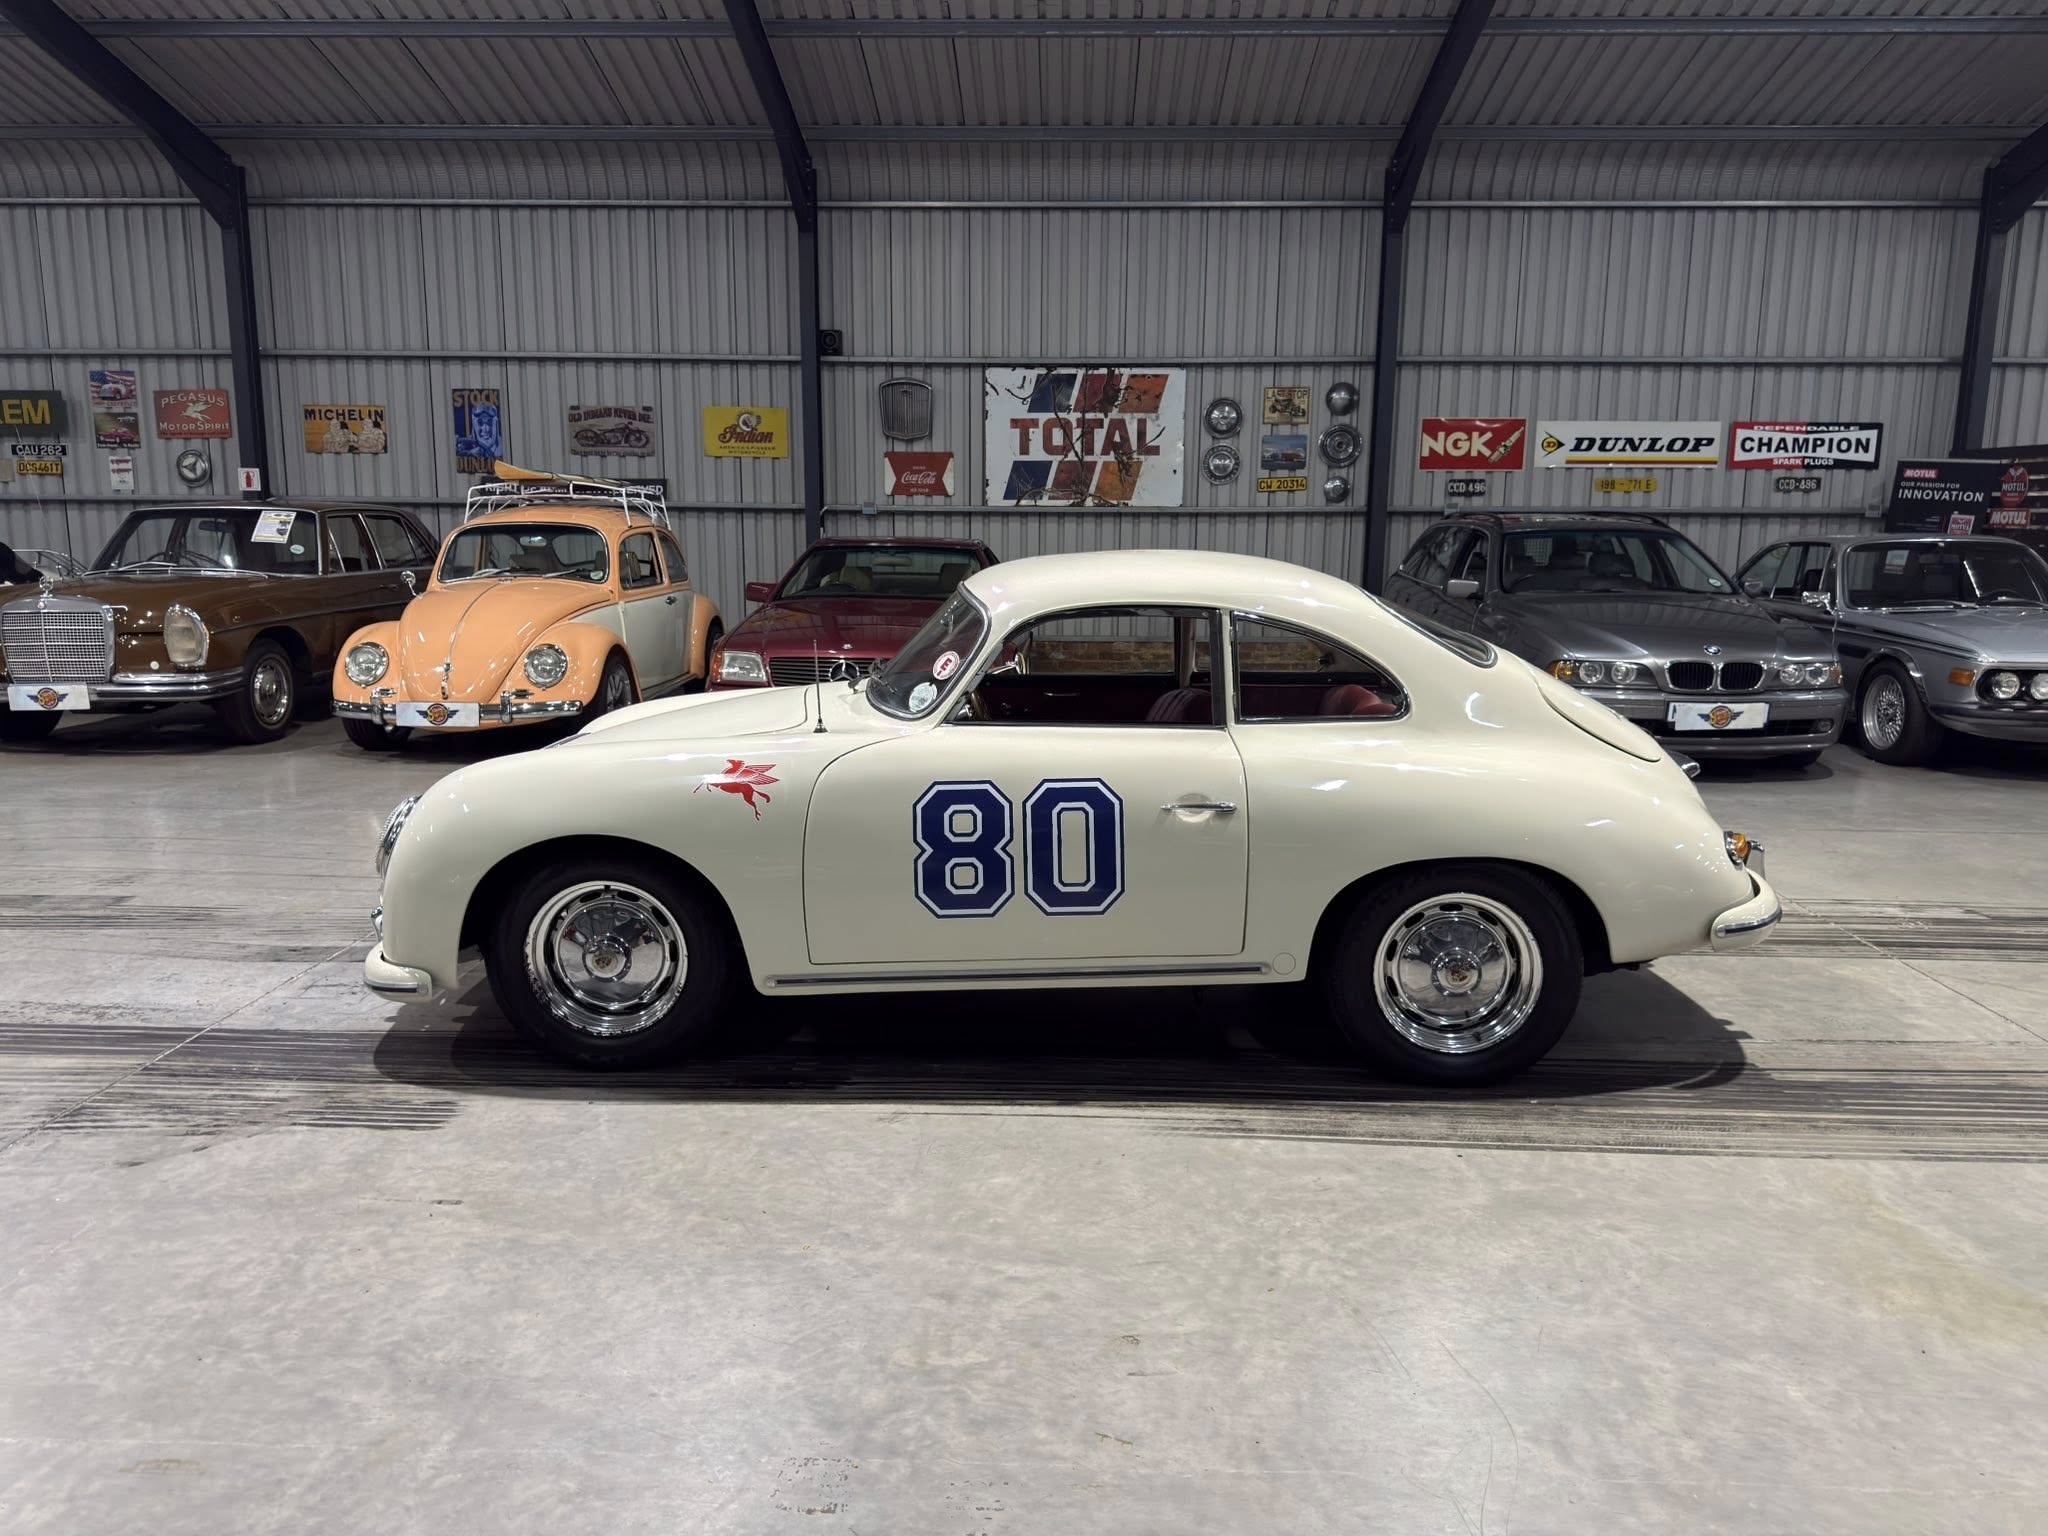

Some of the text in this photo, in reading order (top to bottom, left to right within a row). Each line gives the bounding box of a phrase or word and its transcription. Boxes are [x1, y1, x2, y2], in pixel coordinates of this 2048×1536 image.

[161, 392, 225, 409] PEGASUS
[0, 399, 51, 424] EM
[304, 408, 384, 421] MICHELIN
[160, 420, 230, 431] MOTOR SPIRIT
[718, 423, 774, 444] Indian
[1010, 418, 1161, 456] TOTAL
[1421, 431, 1493, 458] NGK
[1569, 437, 1715, 453] DUNLOP
[1740, 436, 1871, 454] CHAMPION
[457, 456, 500, 473] DUNLO
[1904, 469, 1937, 478] MOTUL
[1276, 479, 1305, 489] 20314
[2002, 482, 2026, 492] MOTUL
[1898, 489, 1984, 503] INNOVATION
[1990, 511, 2027, 525] MOTUL
[913, 778, 1125, 919] 80
